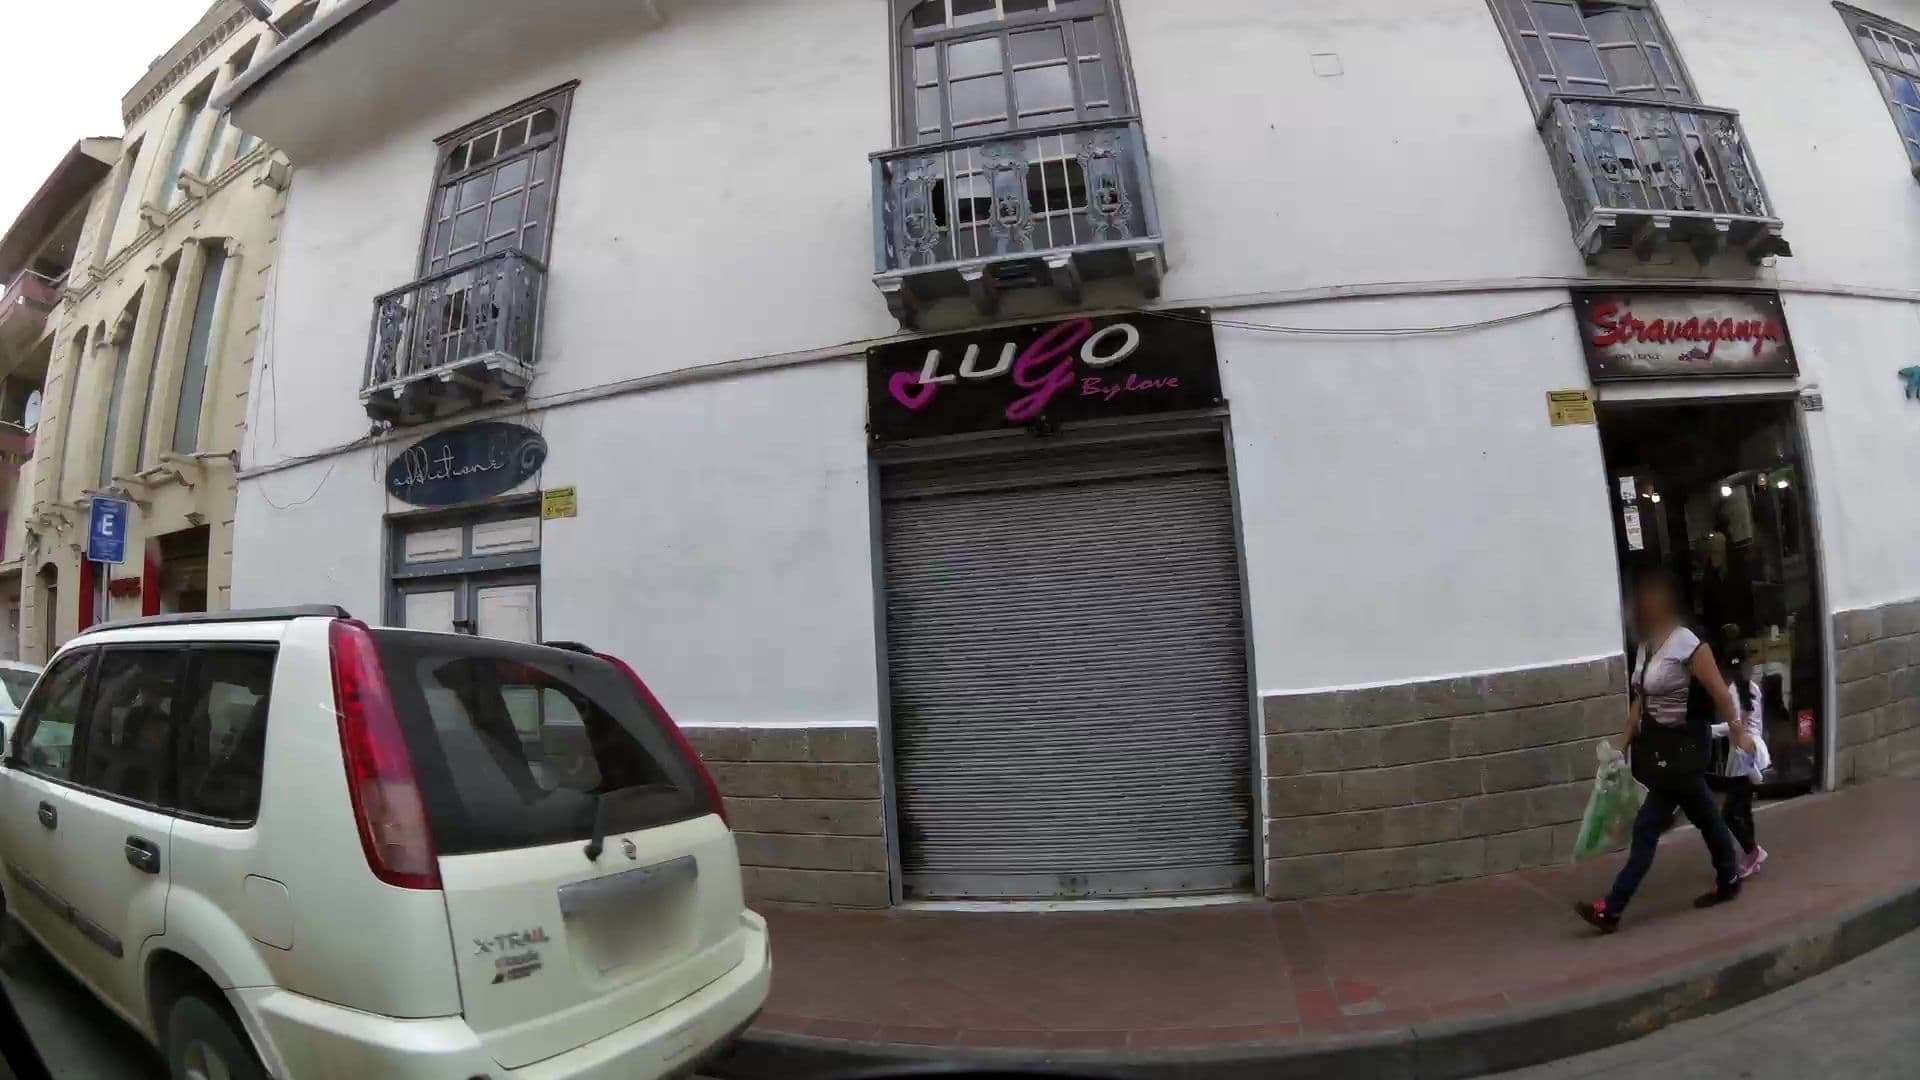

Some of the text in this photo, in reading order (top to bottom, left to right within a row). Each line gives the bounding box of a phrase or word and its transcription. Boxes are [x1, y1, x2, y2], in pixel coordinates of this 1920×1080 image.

[918, 317, 1140, 421] LUGO
[102, 513, 115, 536] E
[472, 926, 550, 956] X-TRAIL
